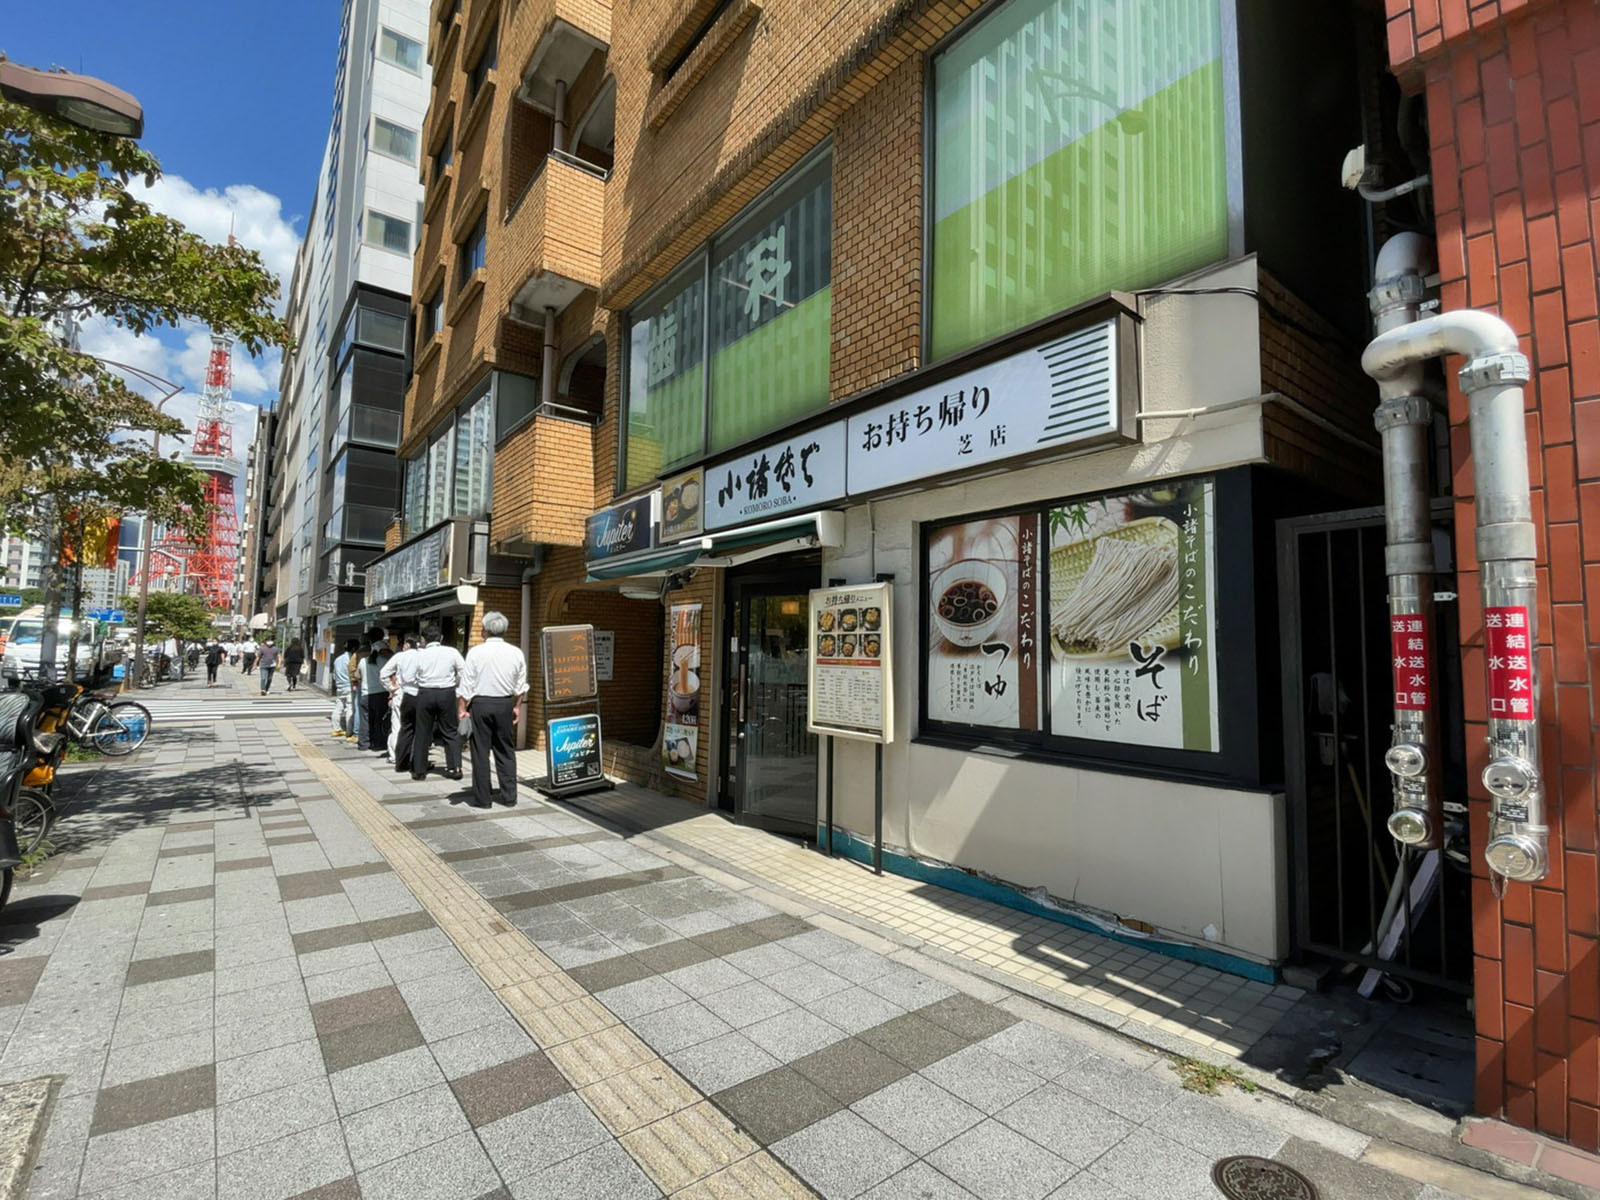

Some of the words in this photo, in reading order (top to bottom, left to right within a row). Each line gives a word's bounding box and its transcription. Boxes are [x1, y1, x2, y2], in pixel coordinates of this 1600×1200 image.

[647, 224, 792, 389] 歯科
[862, 386, 990, 452] お持ち帰り
[596, 513, 634, 552] Jupiter
[744, 498, 773, 515] KOMORO
[773, 495, 793, 508] SOBA
[1020, 528, 1035, 670] 小諸そばのこだわり
[1182, 503, 1204, 676] 小諸そばのこだわり
[981, 642, 1010, 700] つゆ
[1130, 642, 1169, 723] そば
[1393, 621, 1407, 704] 送水口
[1407, 620, 1427, 705] 連結送水管
[1486, 614, 1505, 712] 送水口
[1505, 613, 1529, 713] 連結送水管
[556, 736, 595, 754] Jupiter
